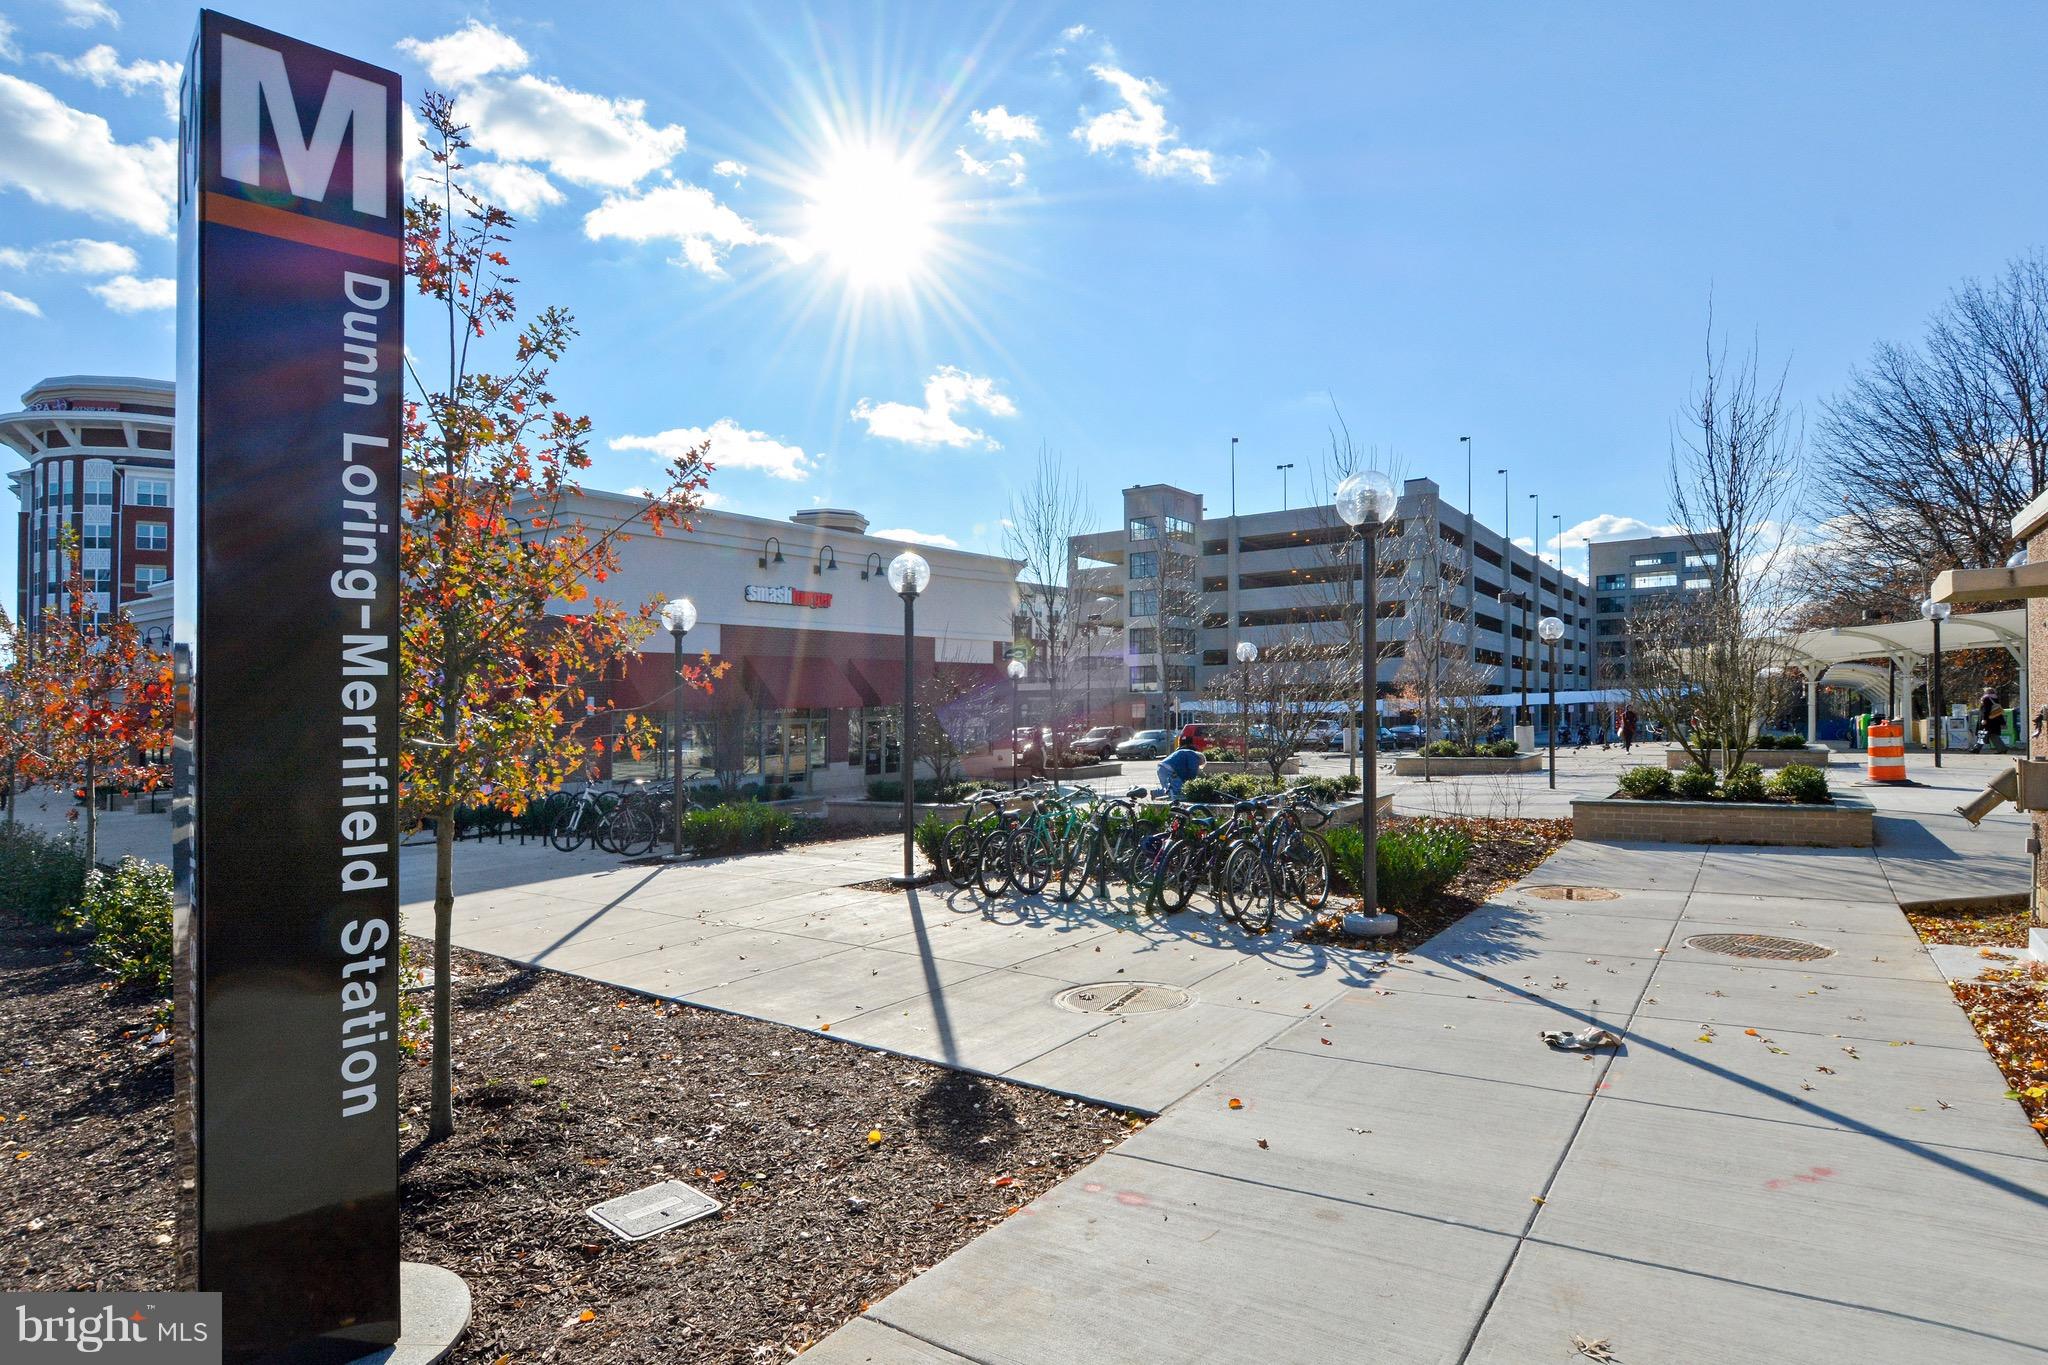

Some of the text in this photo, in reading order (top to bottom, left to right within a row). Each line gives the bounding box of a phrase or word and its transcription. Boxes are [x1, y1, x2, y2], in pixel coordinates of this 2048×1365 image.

[221, 33, 387, 218] M
[343, 271, 390, 406] Dunn
[745, 585, 832, 609] smashburger
[340, 918, 390, 1118] Station
